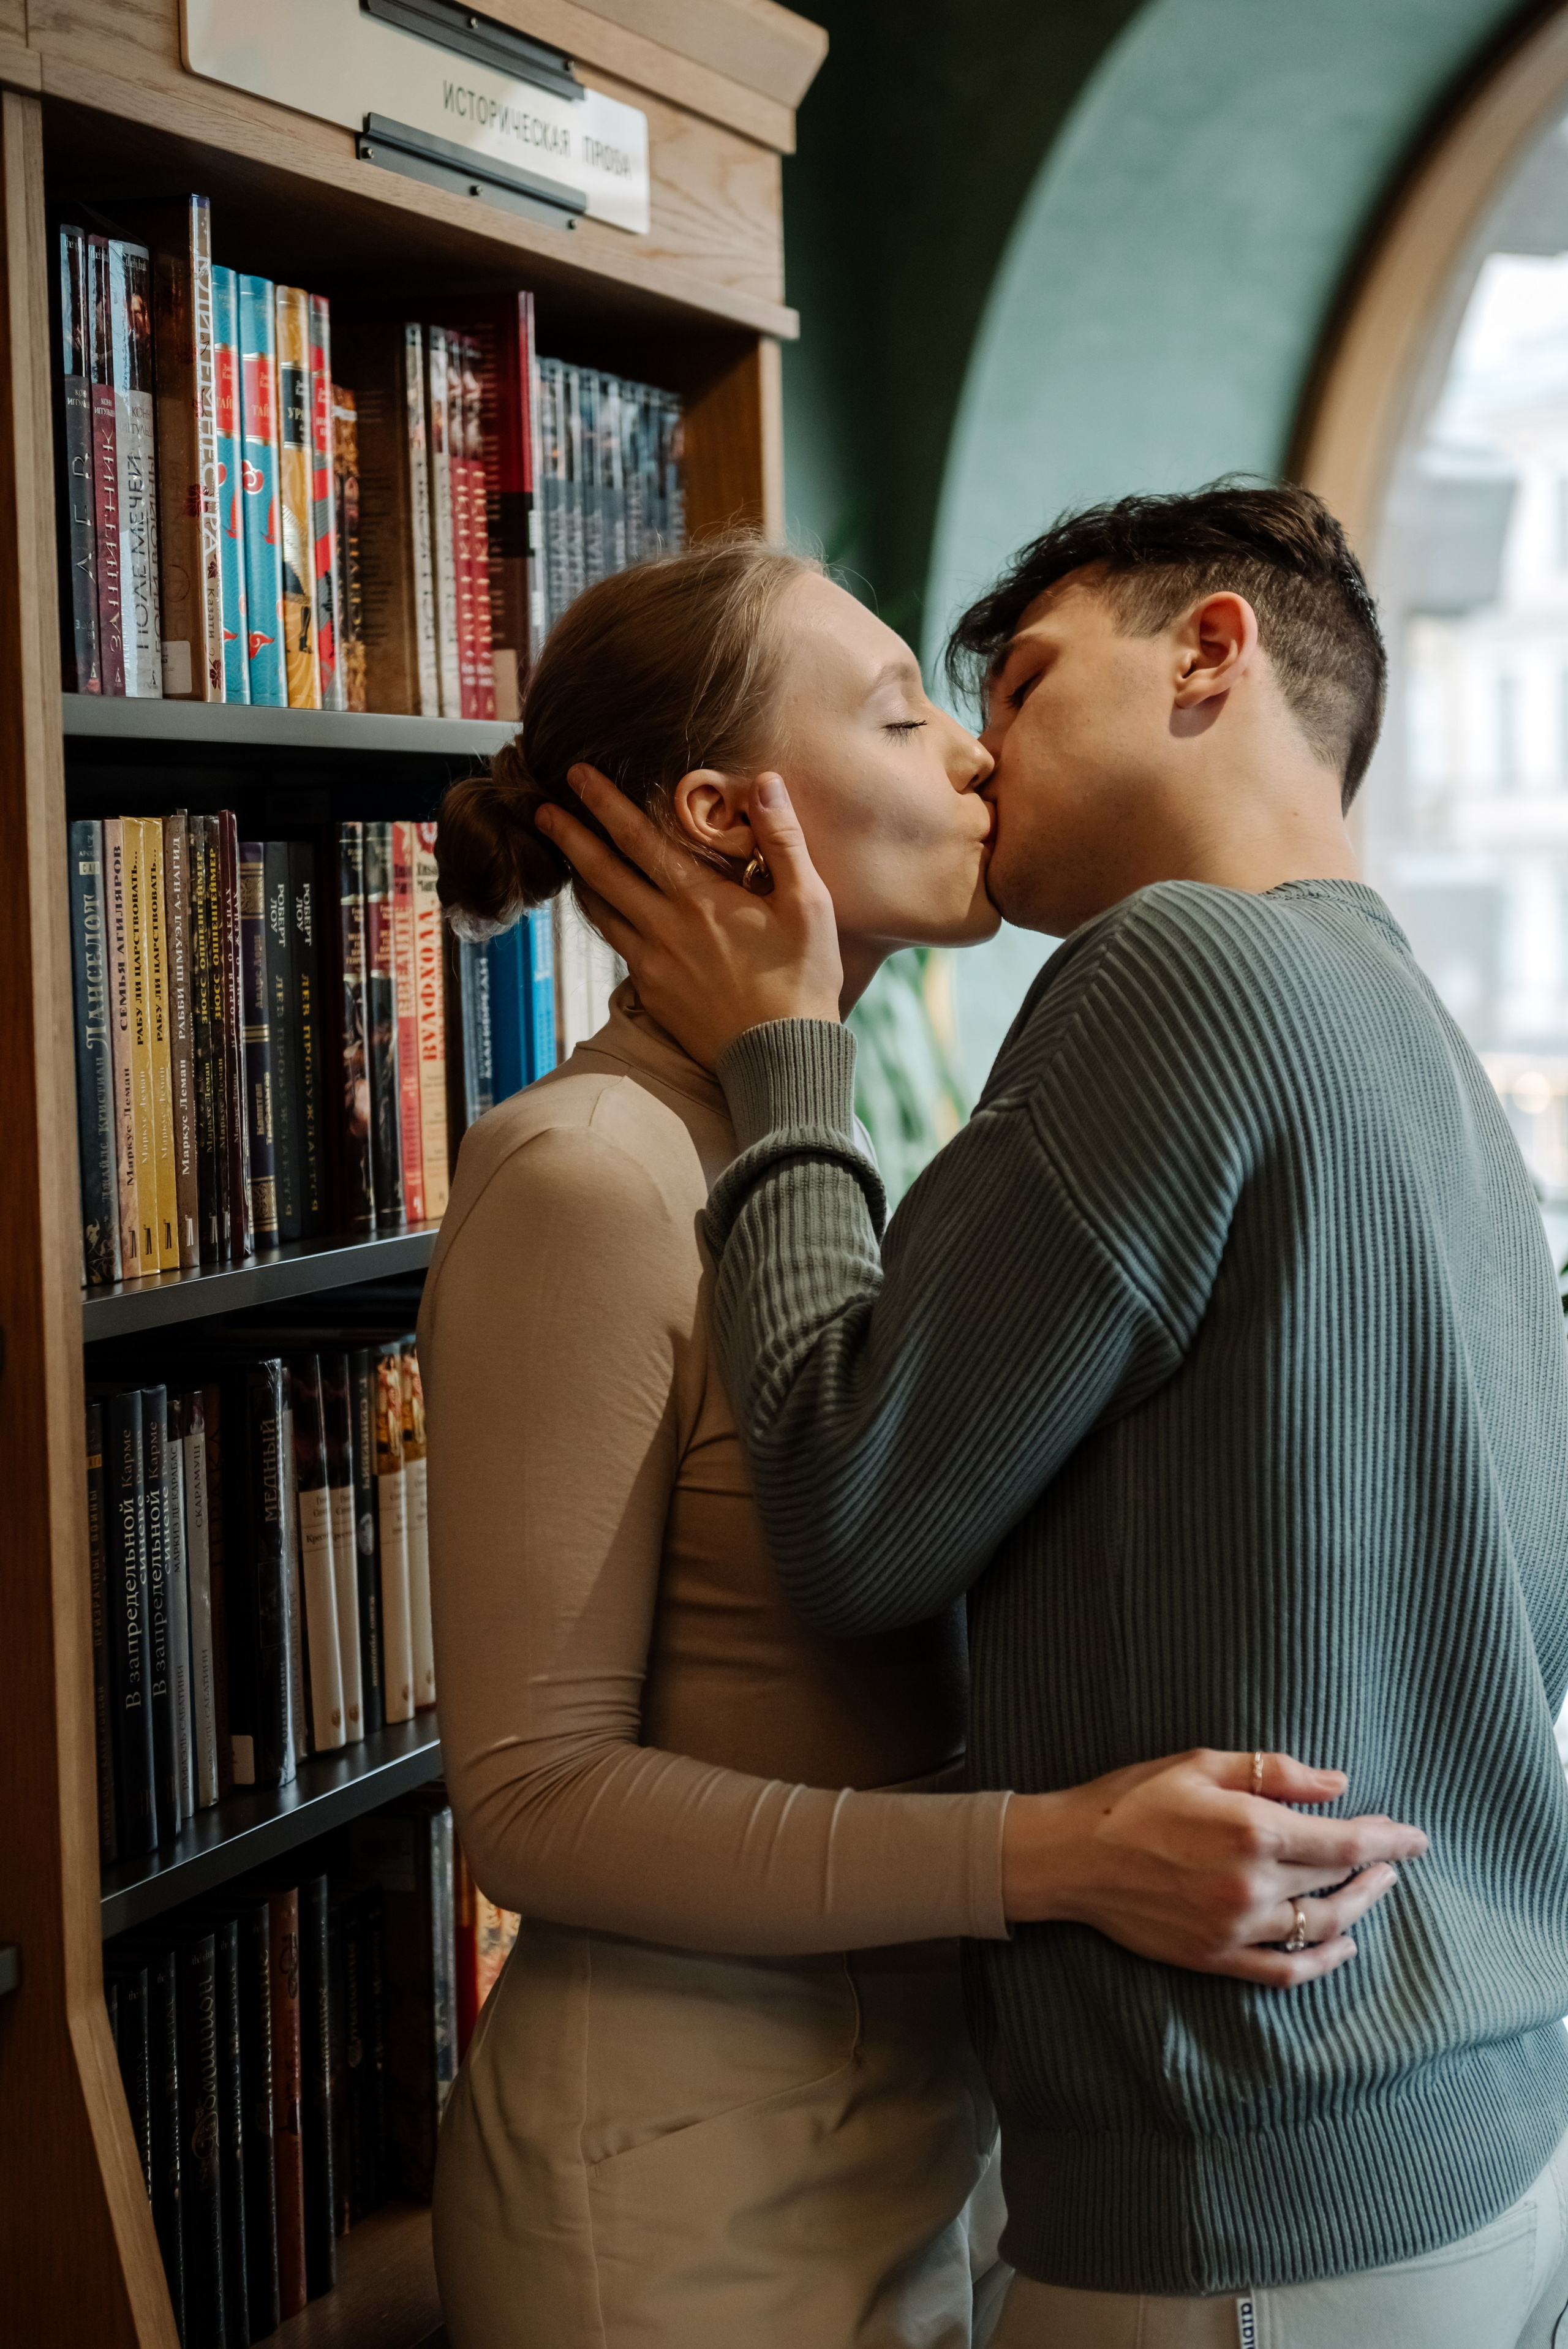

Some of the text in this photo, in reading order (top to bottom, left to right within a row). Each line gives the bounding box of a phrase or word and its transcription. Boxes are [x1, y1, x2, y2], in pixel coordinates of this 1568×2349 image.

[443, 80, 571, 157] ИСТОРИЧЕСКАЯ
[194, 255, 219, 556] КЛИТЕМНЕСТРА
[102, 428, 122, 653] ЗАЩИТНИК
[127, 452, 149, 649] ПОЛЕ МЕЧЕЙ
[207, 587, 216, 639] Казати
[151, 849, 161, 973] ЦАРСТВОВАТЬ...
[173, 837, 182, 910] А-НАГИД
[197, 850, 208, 970] ОППЕНГЕЙМЕР
[210, 848, 219, 966] ОППЕНГЕЙМЕР
[114, 845, 127, 1031] СЕМЬЯ АГИЛЯРОВ
[131, 851, 142, 977] ЦАРСТВОВАТЬ...
[175, 915, 184, 981] ШМУЭЛ
[225, 888, 234, 943] ЖЕНАХ
[270, 897, 279, 933] ЛОУ
[277, 883, 286, 948] РОБЕРТ
[303, 883, 312, 946] РОБЕРТ
[136, 981, 143, 1003] ЛИ
[155, 978, 162, 1000] ЛИ
[227, 953, 233, 962] О
[301, 973, 310, 1017] ЛЕВ
[276, 974, 285, 1018] ЛЕВ
[124, 1068, 135, 1186] Маркус Леман
[181, 1115, 190, 1175] Маркус
[121, 1428, 135, 1489] Карме
[148, 1421, 159, 1480] Карме
[193, 1444, 204, 1529] СКАРАМУШ
[260, 1418, 276, 1523] МЕДНЫЙ
[137, 1494, 147, 1585] синеве
[162, 1485, 172, 1575] синеве
[170, 1445, 182, 1573] МАРКИЗ ДЕ КАРАБАС
[119, 1498, 142, 1711] В запредельной
[146, 1489, 167, 1699] В запредельной
[178, 1665, 187, 1731] САБАТИНИ
[201, 1649, 212, 1722] САБАТИНИ
